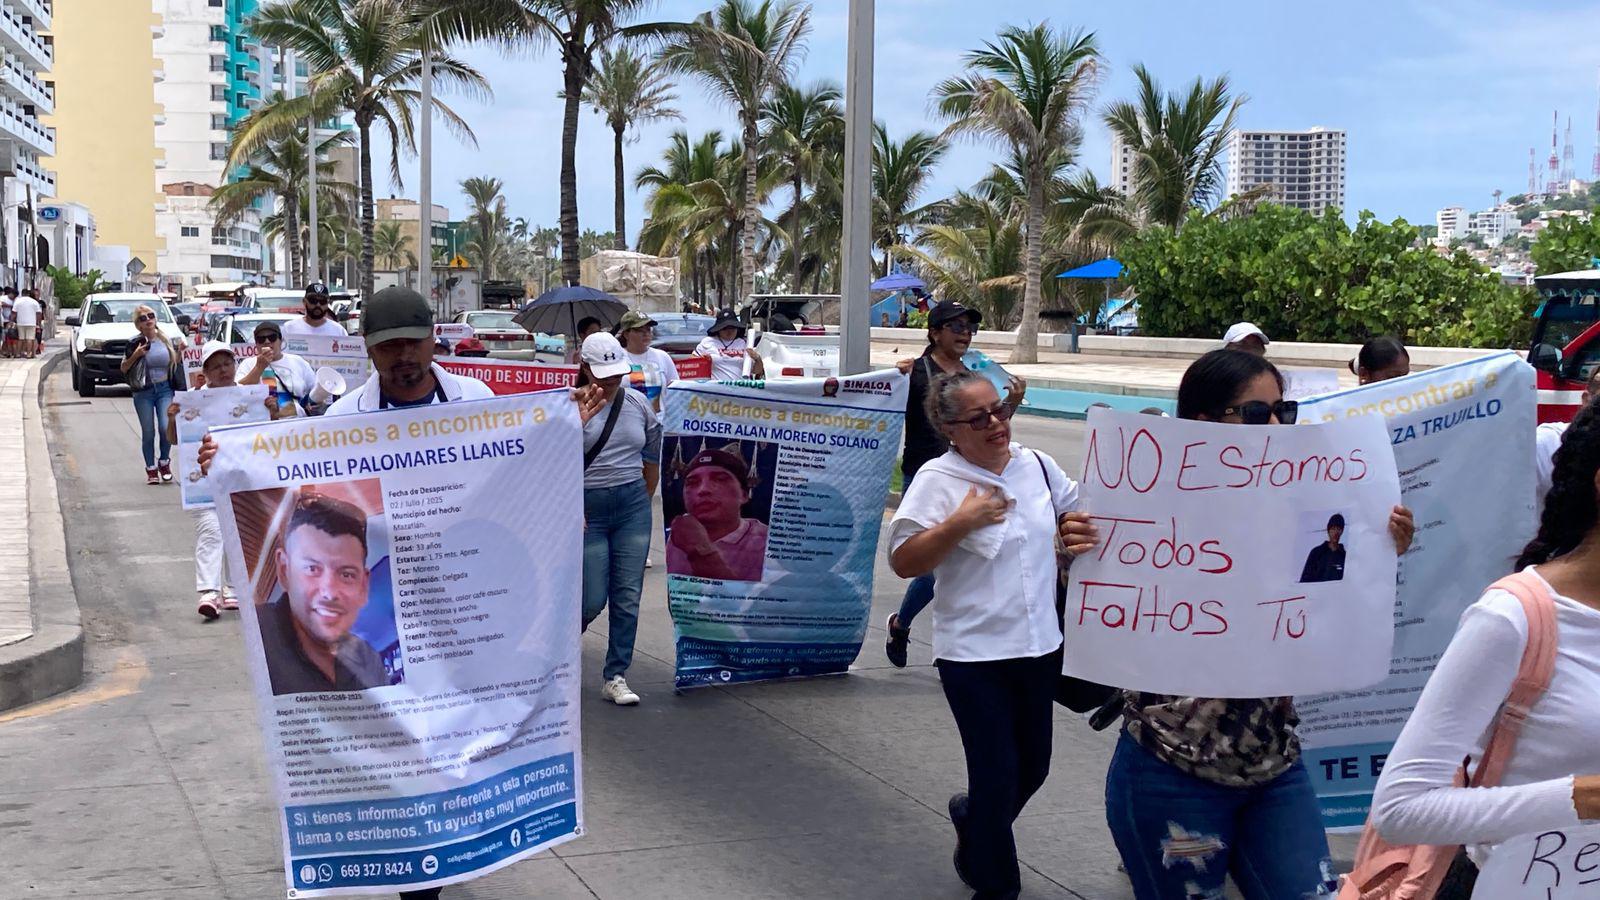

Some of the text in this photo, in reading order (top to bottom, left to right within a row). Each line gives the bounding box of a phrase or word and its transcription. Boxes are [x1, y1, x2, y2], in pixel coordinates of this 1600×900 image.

[495, 369, 511, 383] DE
[515, 370, 531, 384] SU
[535, 372, 577, 386] LIBERT
[844, 380, 892, 391] SINALOA
[1484, 372, 1498, 391] a
[688, 396, 886, 432] Ayúdanos a encontrar a
[1421, 398, 1502, 436] TRUJILLO
[252, 406, 548, 460] Ayúdanos a encontrar a
[683, 419, 880, 450] ROISSER ALAN MORENO SOLANO
[277, 437, 525, 482] DANIEL PALOMARES LLANES
[1083, 427, 1163, 493] NO
[388, 482, 466, 498] Fecha de Desaparición:
[389, 501, 400, 510] 02
[426, 496, 444, 505] 2025
[391, 504, 462, 521] Municipio del hecho:
[393, 521, 427, 532] Mazatlán.
[394, 531, 442, 543] Sexo: Hombre
[1089, 516, 1233, 574] Todos
[395, 544, 415, 554] Edad:
[425, 541, 442, 551] años
[396, 548, 481, 565] Estatura: 1.75 mts. Aprox.
[397, 563, 440, 576] Tez: Moreno
[398, 571, 468, 587] Complexión: Delgada
[399, 586, 446, 598] Cara: Ovalada
[400, 600, 418, 609] Ojos:
[455, 593, 472, 602] color
[401, 610, 422, 619] Nariz:
[1078, 581, 1307, 642] Faltas Tú
[402, 620, 430, 631] Cabello:
[470, 612, 490, 624] negro
[404, 628, 458, 642] Frente: Pequeña
[406, 643, 423, 653] Boca:
[476, 631, 505, 644] delgados
[408, 648, 474, 665] Cejas: Semi pobladas
[469, 685, 495, 695] redondo
[500, 680, 521, 690] manga
[1319, 756, 1360, 781] TE
[293, 811, 308, 827] Si
[312, 808, 353, 826] tienes
[357, 801, 437, 822] información
[442, 787, 493, 812] referente
[494, 785, 501, 796] a
[501, 776, 521, 794] esta
[523, 762, 570, 787] persona,
[296, 830, 332, 846] llama
[334, 832, 344, 842] o
[424, 819, 442, 834] Tu
[444, 810, 483, 831] ayuda
[484, 806, 496, 819] es
[496, 798, 515, 819] muy
[515, 780, 570, 809] importante.
[340, 860, 414, 878] 669 327 8424
